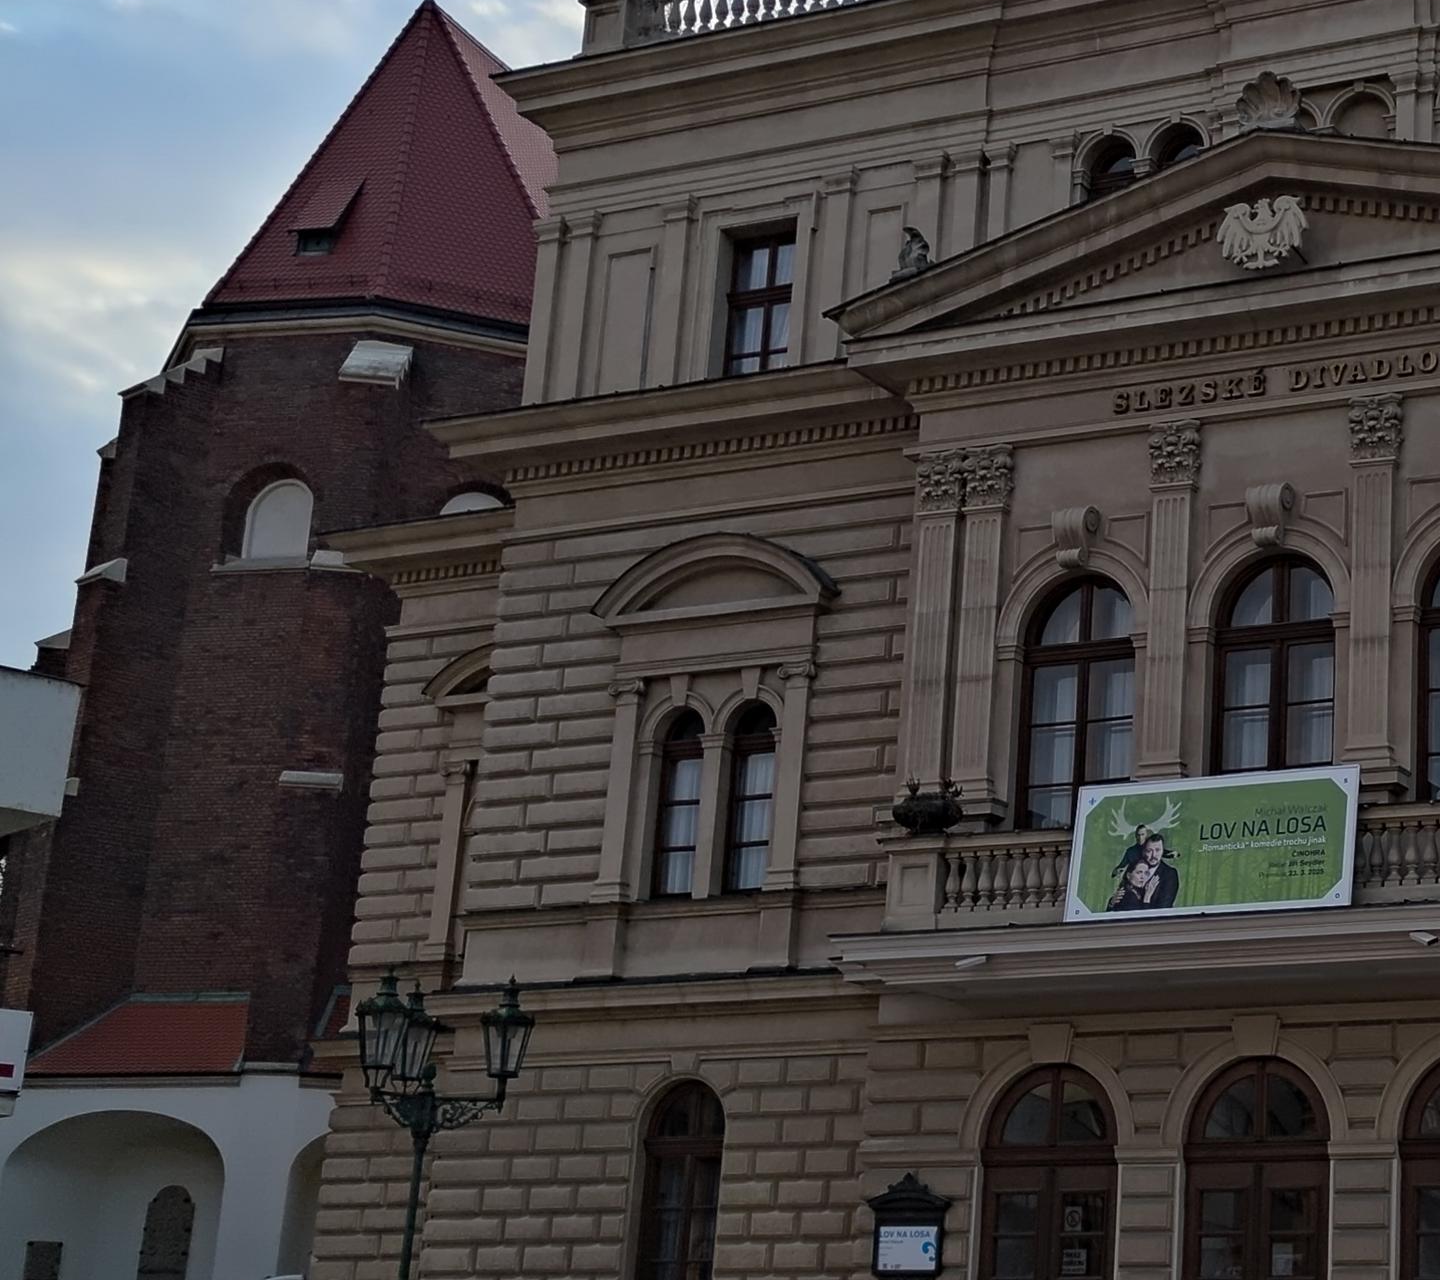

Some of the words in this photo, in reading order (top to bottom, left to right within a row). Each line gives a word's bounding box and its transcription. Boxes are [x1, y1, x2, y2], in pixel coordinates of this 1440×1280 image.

[1112, 368, 1267, 414] SLEZSKÉ
[1288, 350, 1439, 392] DIVADLO
[1199, 822, 1237, 841] LOV
[1241, 820, 1270, 838] NA
[1275, 815, 1327, 835] LOSA
[1250, 839, 1282, 848] komedie
[1282, 836, 1308, 846] trochu
[1307, 835, 1327, 846] jinak
[896, 1230, 908, 1239] NA
[909, 1230, 930, 1239] LOSA
